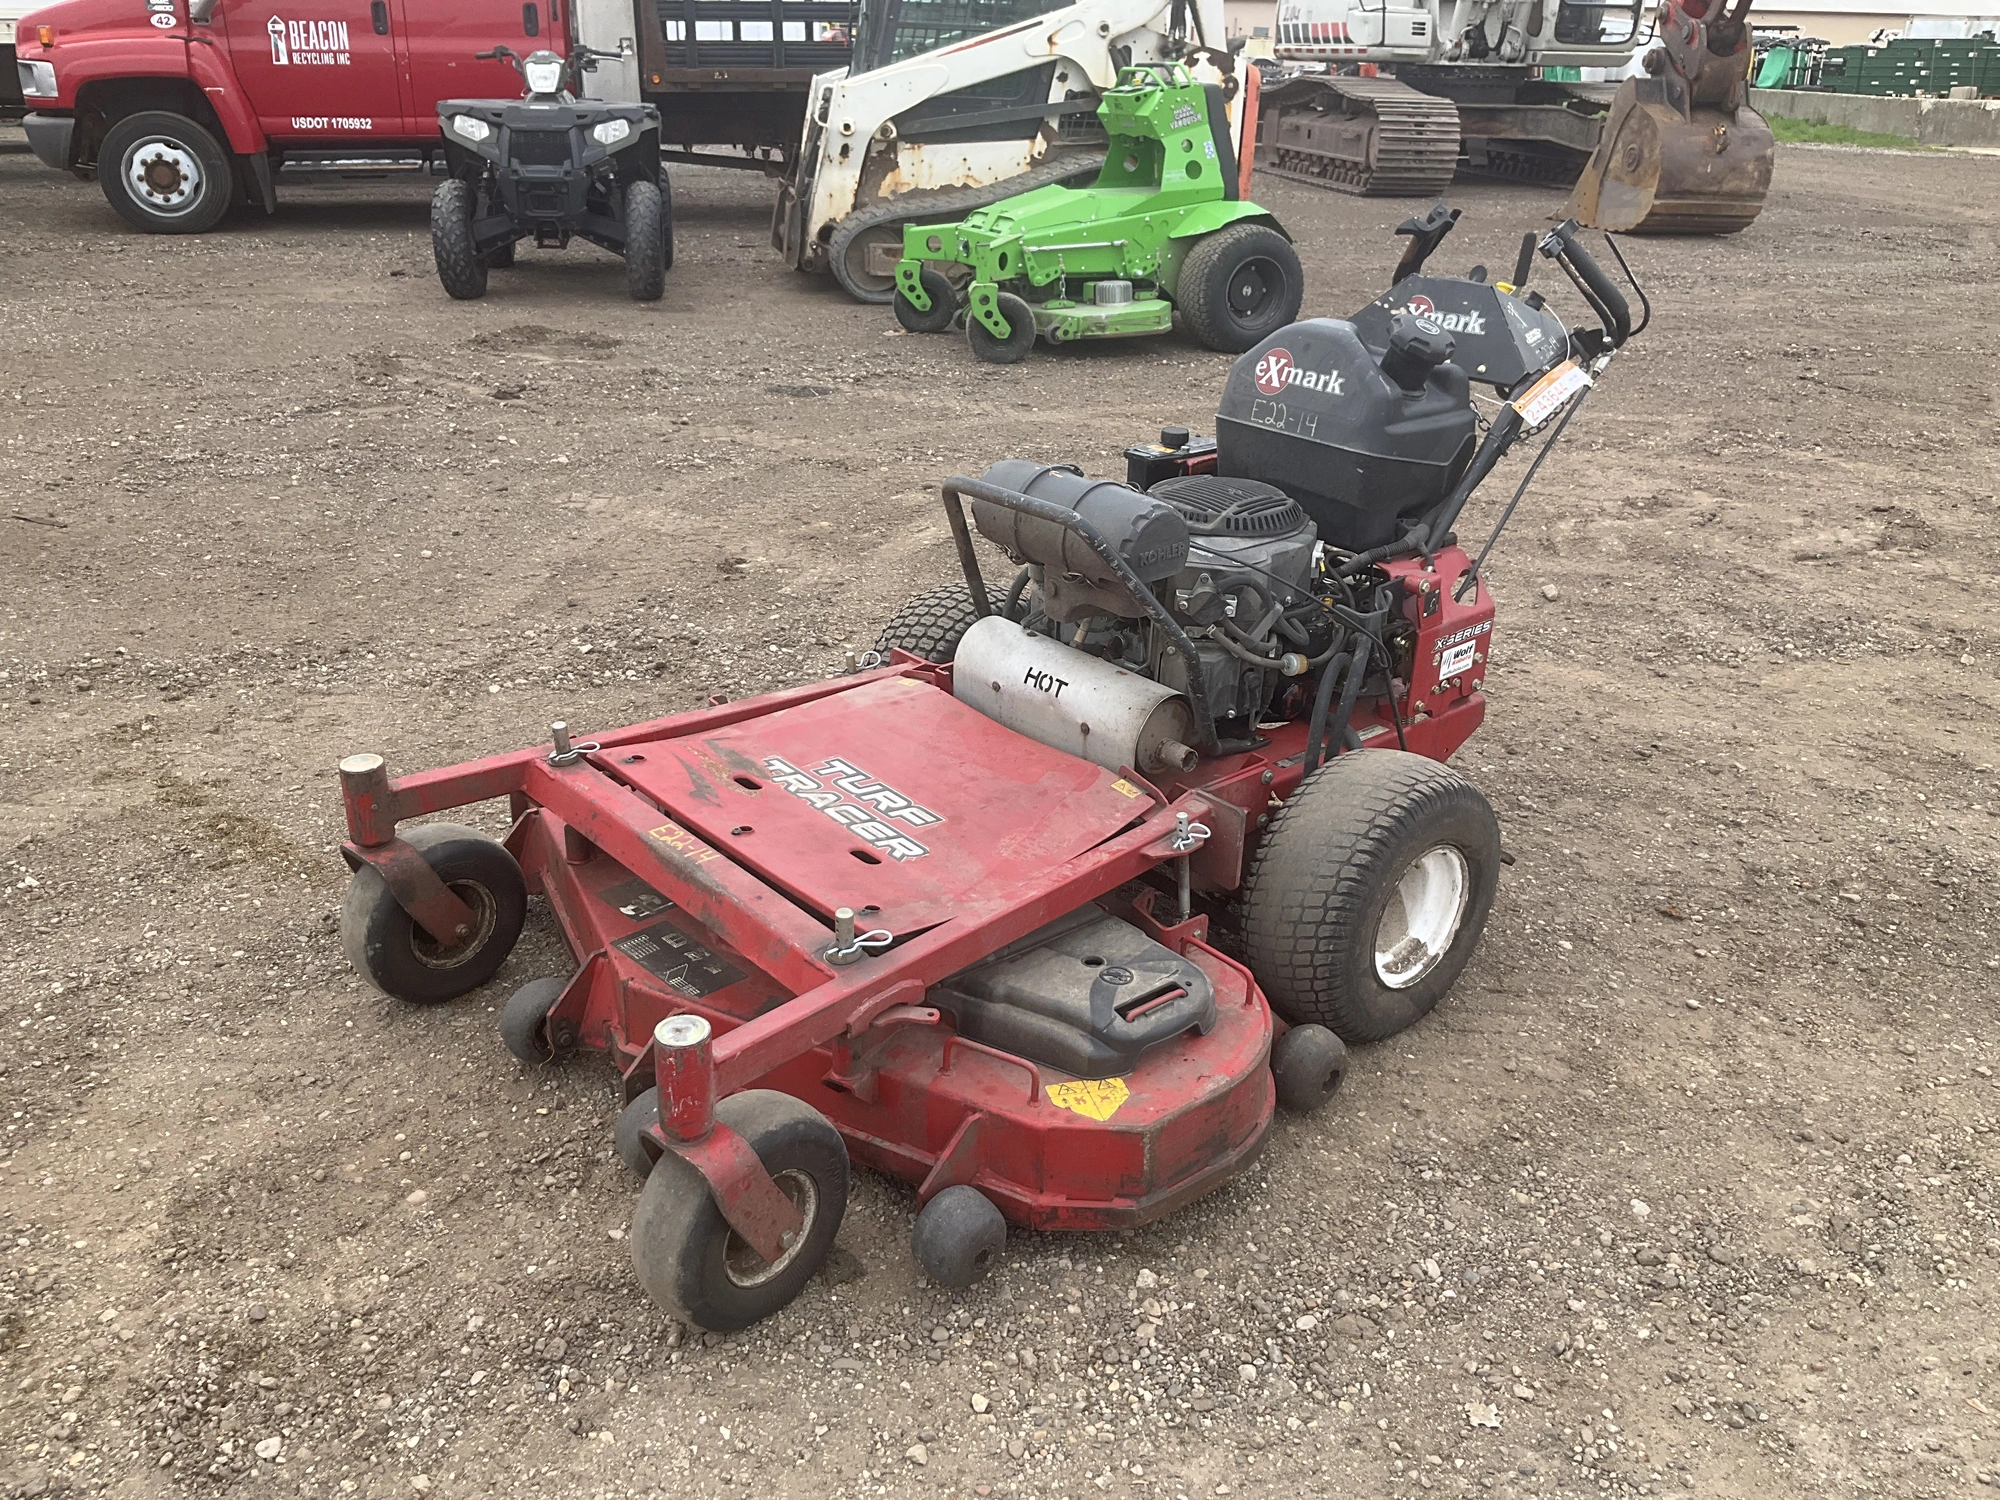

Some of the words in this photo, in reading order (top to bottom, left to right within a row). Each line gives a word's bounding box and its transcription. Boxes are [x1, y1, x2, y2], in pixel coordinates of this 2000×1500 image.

[156, 16, 172, 26] 42
[288, 20, 350, 51] BEACON
[292, 52, 335, 65] RECYCLING
[336, 52, 351, 65] INC
[291, 117, 329, 129] USDOT
[331, 117, 373, 130] 1705932
[1255, 355, 1346, 396] eXmark
[1250, 398, 1319, 438] E22-14
[1138, 541, 1187, 567] KOHLER
[1432, 619, 1493, 652] X-SERIES
[1023, 666, 1069, 698] HOT
[811, 756, 947, 828] TURF
[763, 755, 930, 862] TRACER
[648, 823, 720, 865] E22-14
